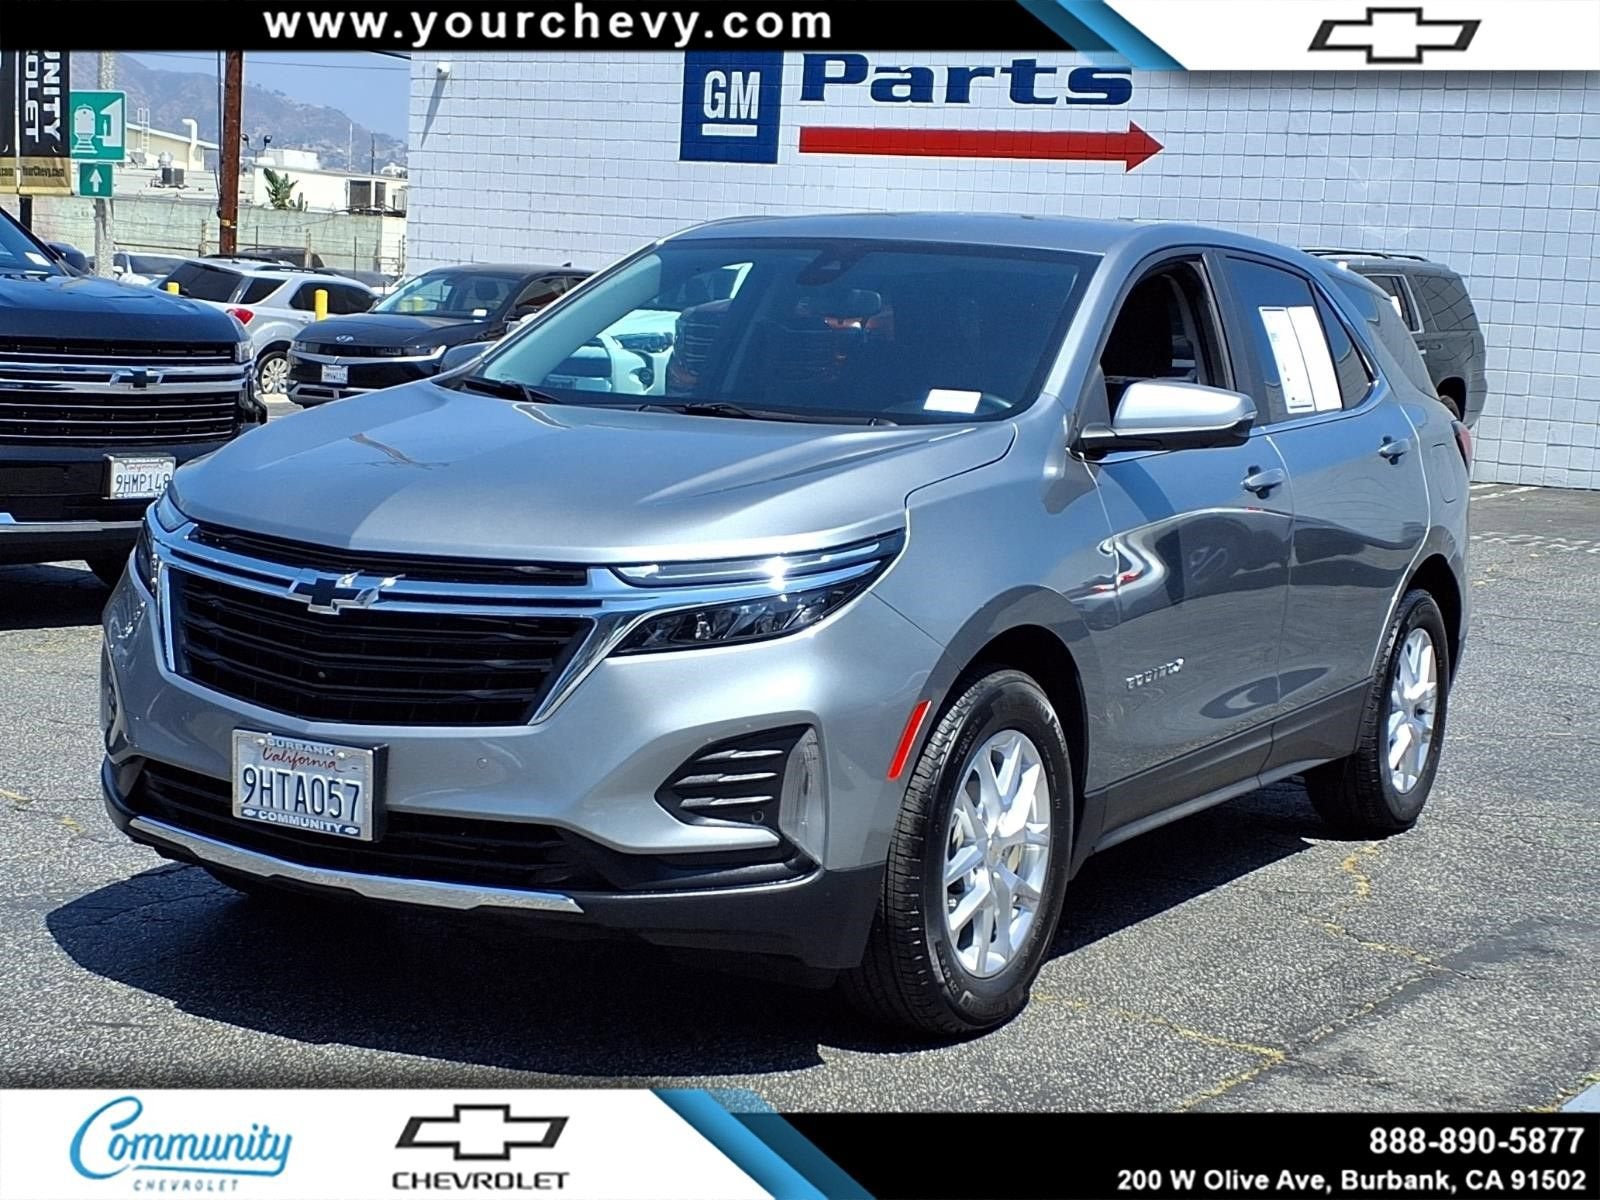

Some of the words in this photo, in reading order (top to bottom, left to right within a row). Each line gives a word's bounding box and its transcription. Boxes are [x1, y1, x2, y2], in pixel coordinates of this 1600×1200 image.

[25, 51, 39, 143] OLET
[703, 70, 761, 120] GM
[800, 53, 1133, 106] Parts
[262, 747, 345, 773] California
[266, 738, 335, 757] BURBANK
[242, 766, 361, 822] 9HTA057
[257, 810, 343, 834] COMMUNITY
